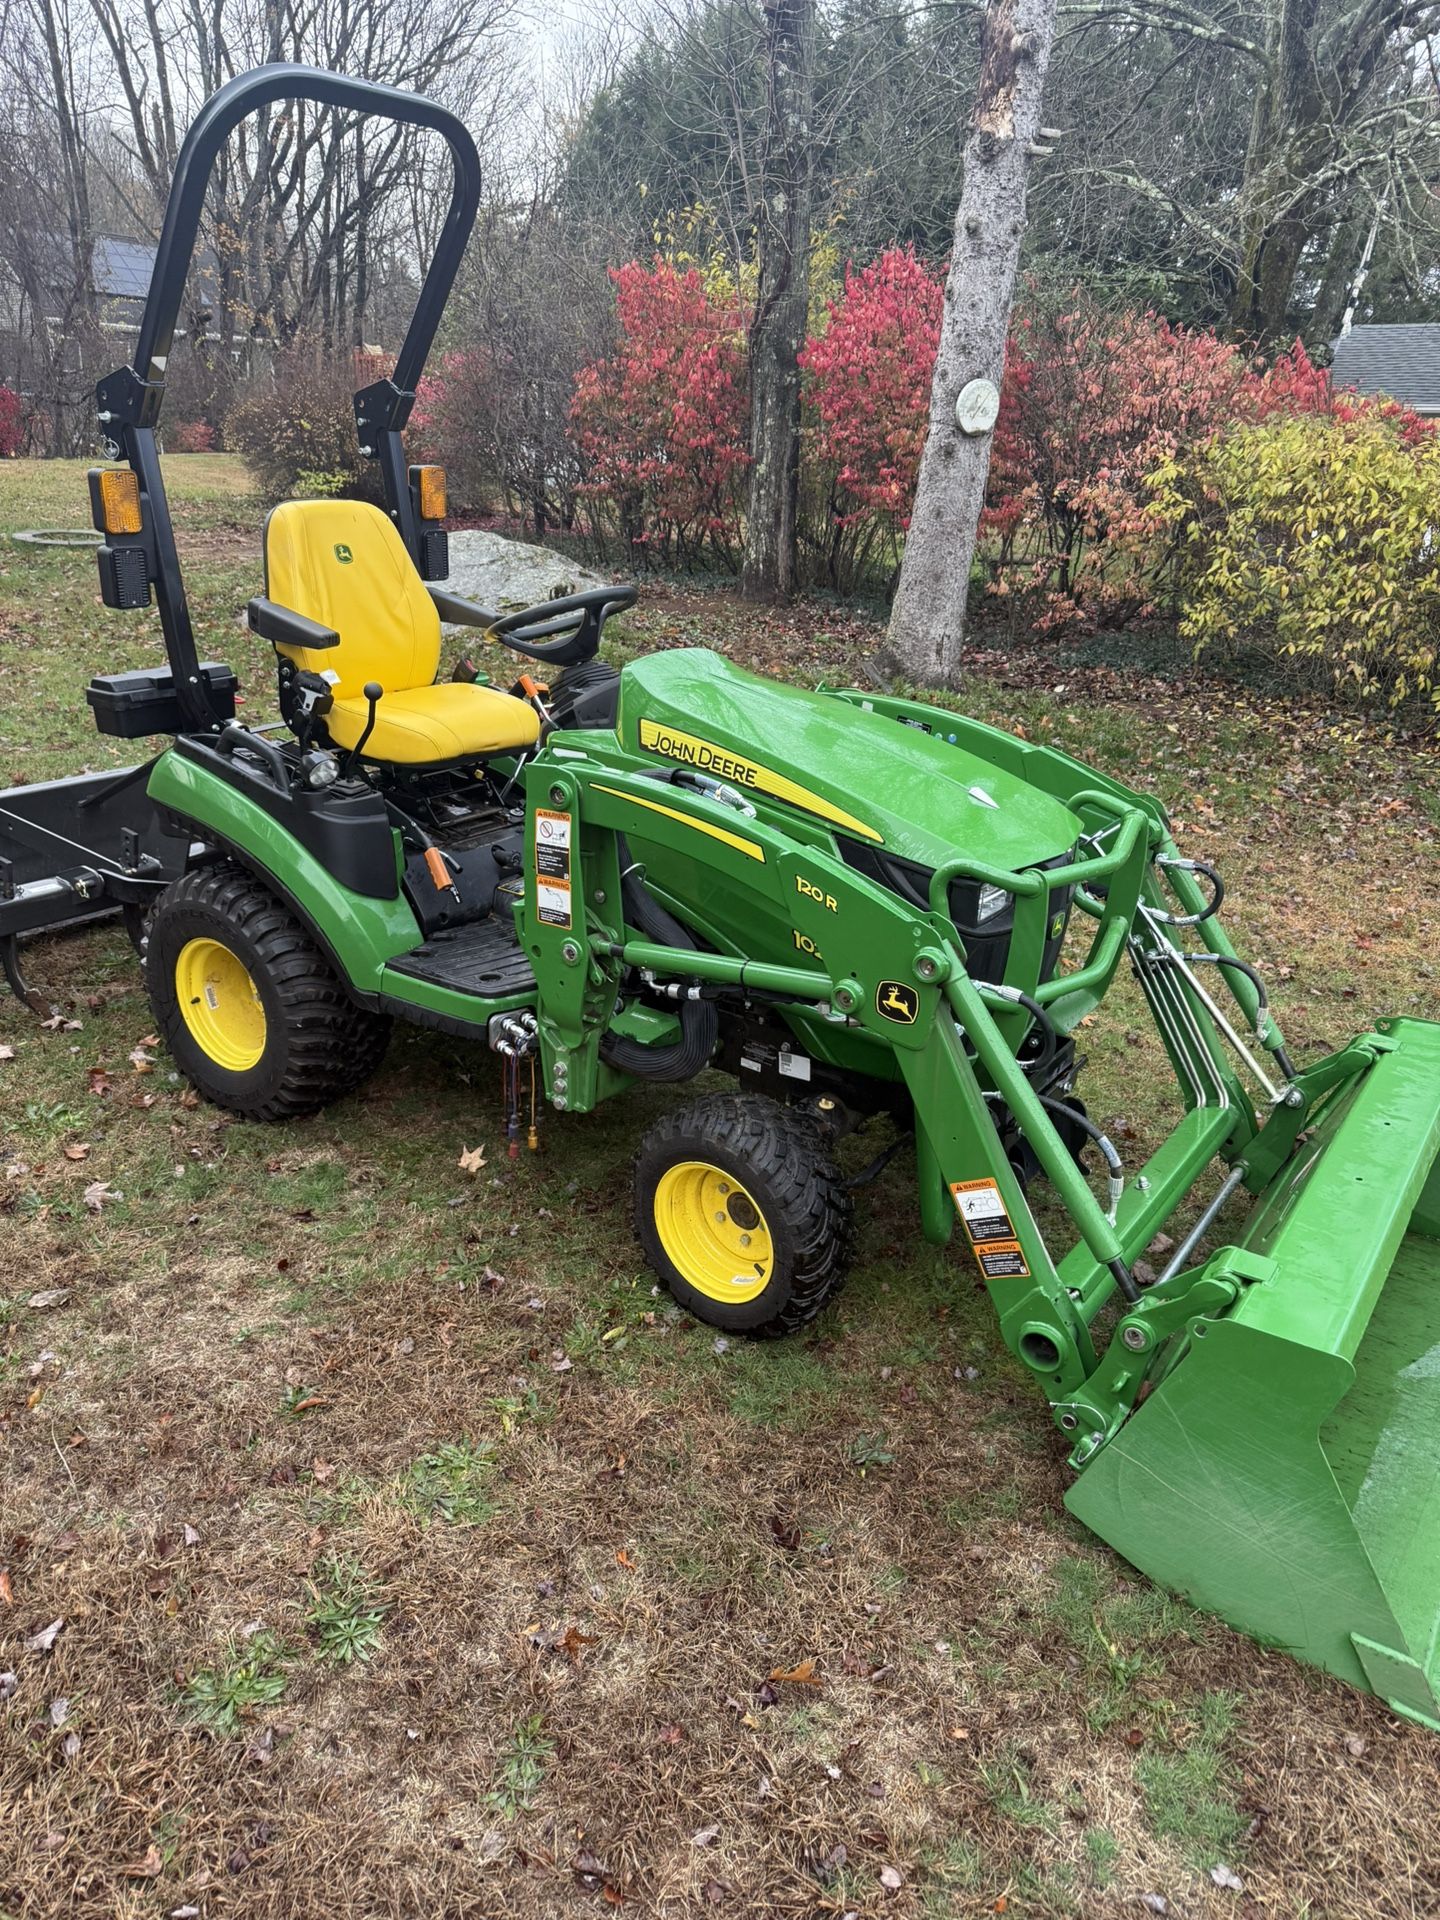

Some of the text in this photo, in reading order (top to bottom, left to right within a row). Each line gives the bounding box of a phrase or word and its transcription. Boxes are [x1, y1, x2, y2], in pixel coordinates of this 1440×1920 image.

[650, 731, 758, 786] JOHN DEERE
[542, 811, 571, 821] WARNING
[542, 878, 571, 890] WARNING
[962, 1180, 992, 1190] WARNING
[986, 1244, 1017, 1252] WARNING
